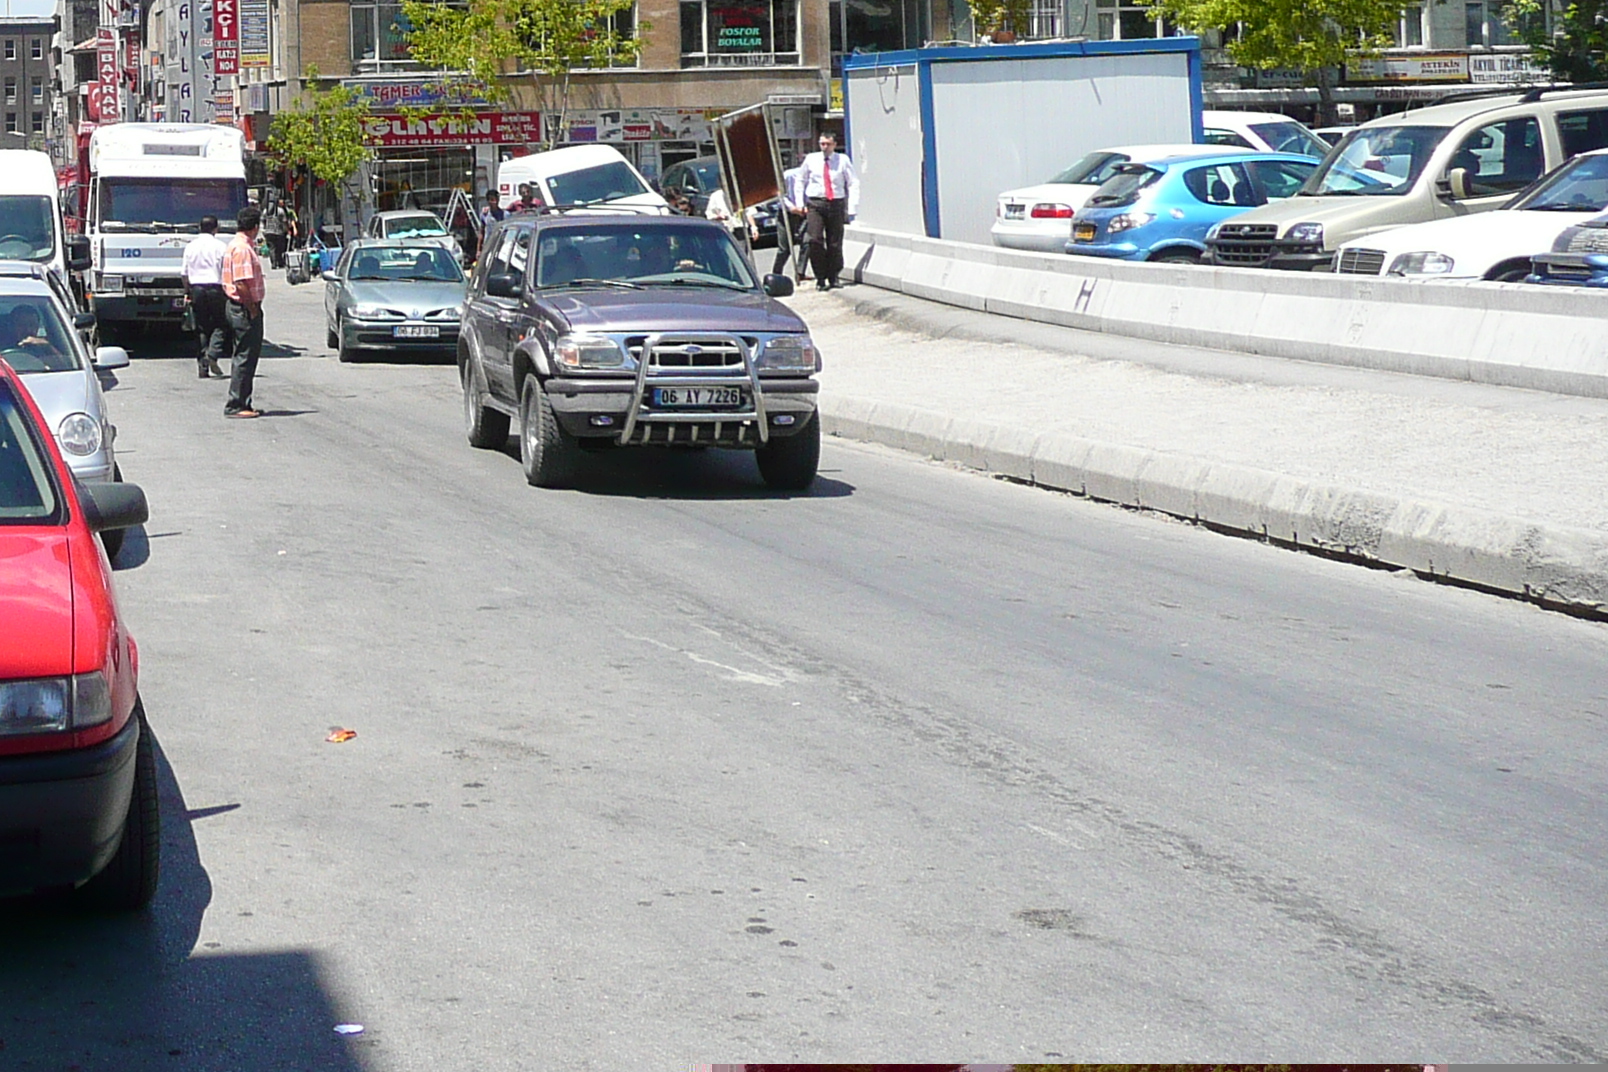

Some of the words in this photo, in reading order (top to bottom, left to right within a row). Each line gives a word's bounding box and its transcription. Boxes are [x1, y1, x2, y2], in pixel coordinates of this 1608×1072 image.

[719, 27, 760, 36] FOSFOR
[717, 37, 762, 47] BOYALAR
[101, 53, 117, 115] BAYRAK
[372, 84, 423, 102] TAMER
[661, 389, 679, 405] 06
[707, 387, 739, 404] 7226
